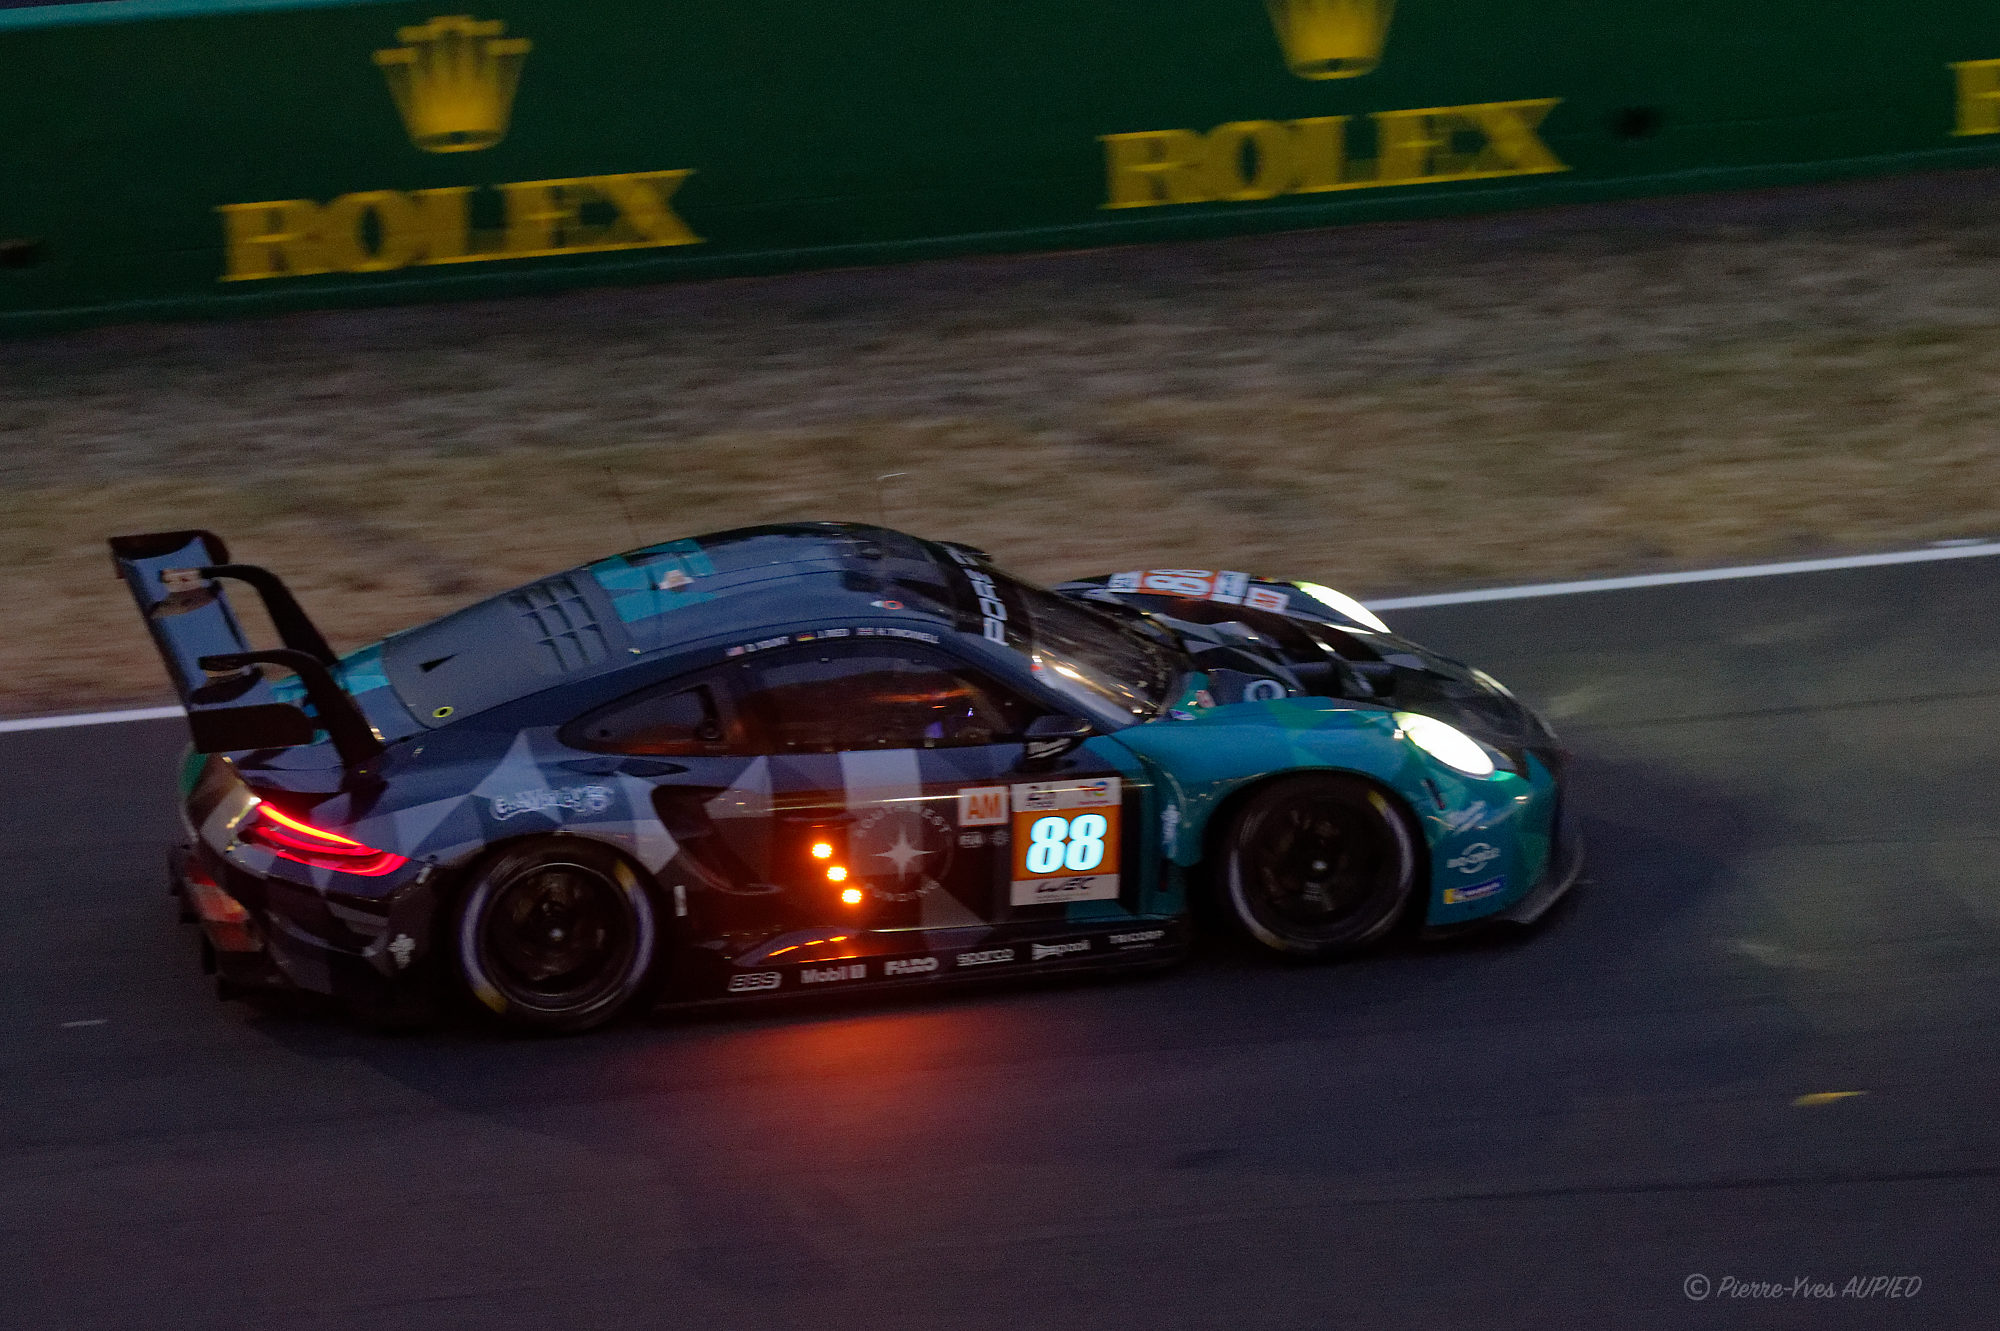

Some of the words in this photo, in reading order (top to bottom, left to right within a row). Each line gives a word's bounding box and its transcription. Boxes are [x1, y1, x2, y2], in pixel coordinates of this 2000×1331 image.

[1095, 97, 1572, 210] ROLEX
[214, 168, 706, 282] ROLEX
[967, 793, 1002, 820] AM
[1025, 813, 1108, 874] 88
[801, 965, 846, 984] Mobil
